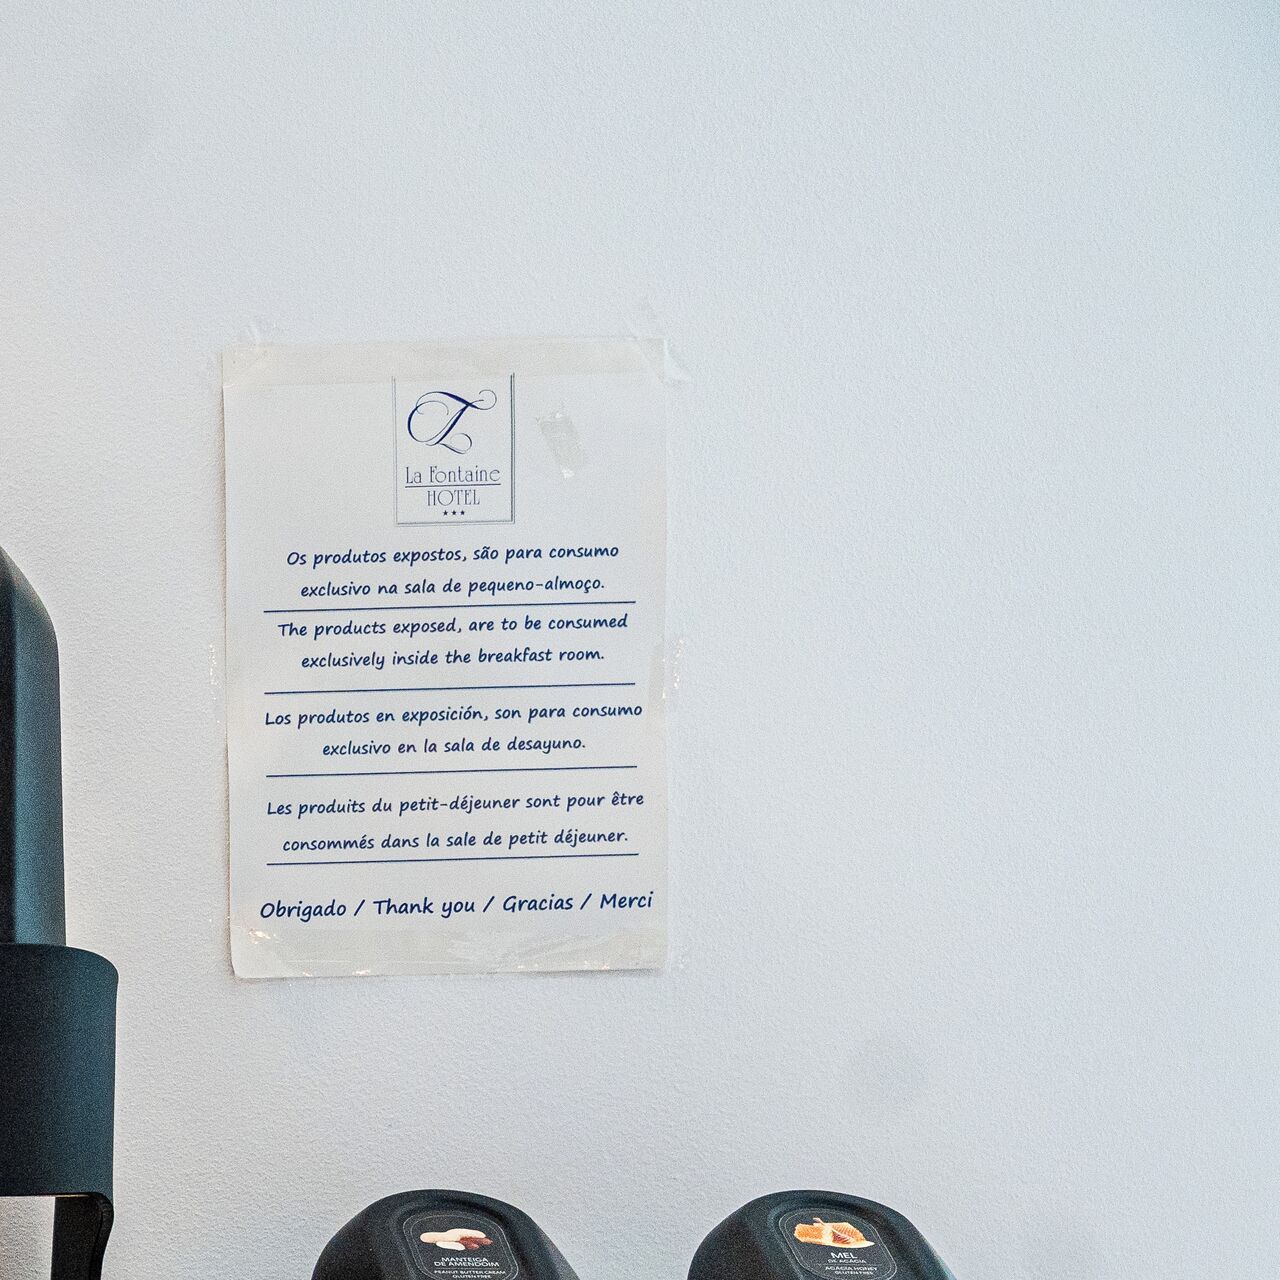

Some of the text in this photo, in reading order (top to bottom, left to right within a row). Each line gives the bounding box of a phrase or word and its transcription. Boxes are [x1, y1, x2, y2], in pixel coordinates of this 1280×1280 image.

[405, 464, 502, 486] La Fontaine
[426, 488, 481, 507] HOTEL
[286, 545, 620, 570] Os produtos expostos, são para consumo
[300, 575, 605, 598] exclusivo na sala de pequeno-almoço.
[277, 612, 629, 642] The products exposed, are to be consumed
[301, 646, 605, 671] exclusively inside the breakfast room.
[264, 705, 643, 730] Los produtos en exposición, son para consumo
[322, 735, 586, 756] exclusivo en la sala de desayuno.
[266, 790, 645, 820] Les produits du petit-déjeuner sont pour être
[282, 828, 629, 852] consommés dans la sale de petit déjeuner.
[259, 890, 655, 924] Obrigado / Thank you / Gracias / Merci
